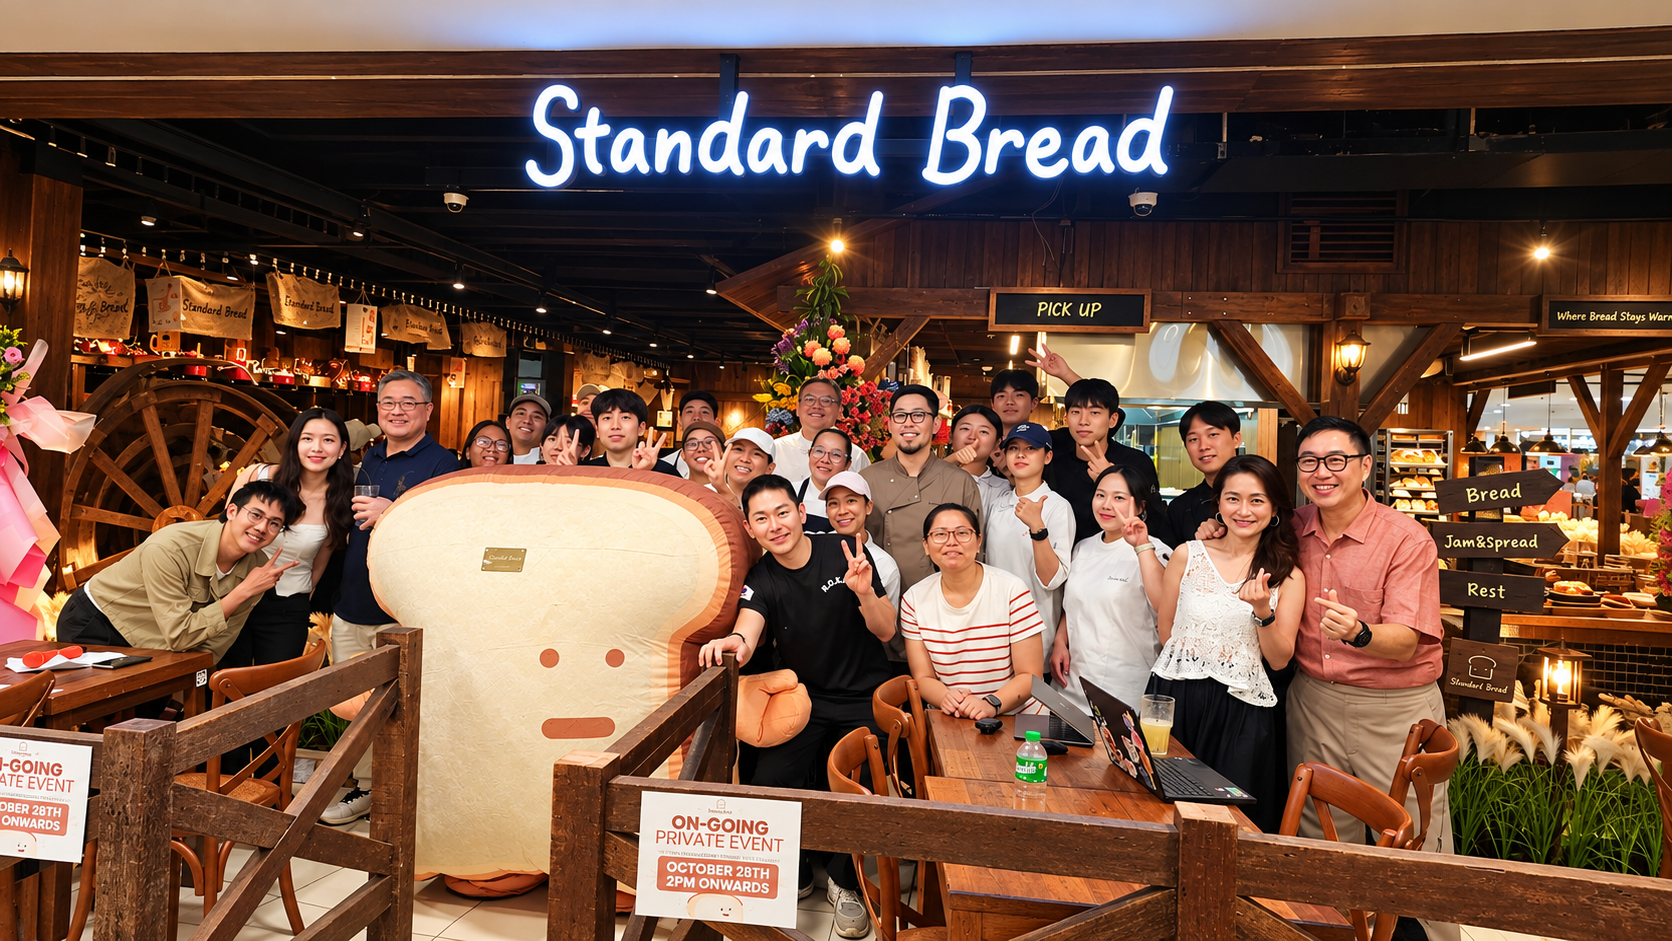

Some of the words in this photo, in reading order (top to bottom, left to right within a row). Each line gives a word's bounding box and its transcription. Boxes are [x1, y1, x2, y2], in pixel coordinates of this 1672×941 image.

[525, 83, 885, 188] Standard
[921, 84, 1175, 187] Bread
[182, 299, 223, 316] Standard
[224, 305, 248, 320] Bread
[1037, 301, 1074, 317] PICK
[1078, 302, 1102, 318] UP
[1556, 311, 1587, 321] Where
[1589, 311, 1618, 321] Bread
[1620, 311, 1646, 325] Stays
[1465, 482, 1522, 503] Bread
[1444, 534, 1539, 552] Jam&Spread
[821, 576, 846, 593] R.O.K.
[1467, 582, 1506, 599] Rest
[0, 757, 63, 777] -GOING
[27, 776, 75, 793] EVENT
[32, 804, 62, 818] 28TH
[1, 815, 61, 832] ONWARDS
[671, 814, 769, 836] ON-GOING
[656, 829, 725, 849] PRIVATE
[729, 835, 784, 853] EVENT
[666, 861, 733, 877] OCTOBER
[735, 866, 770, 880] 28TH
[665, 875, 696, 888] 2PM
[698, 877, 770, 894] ONWARDS
